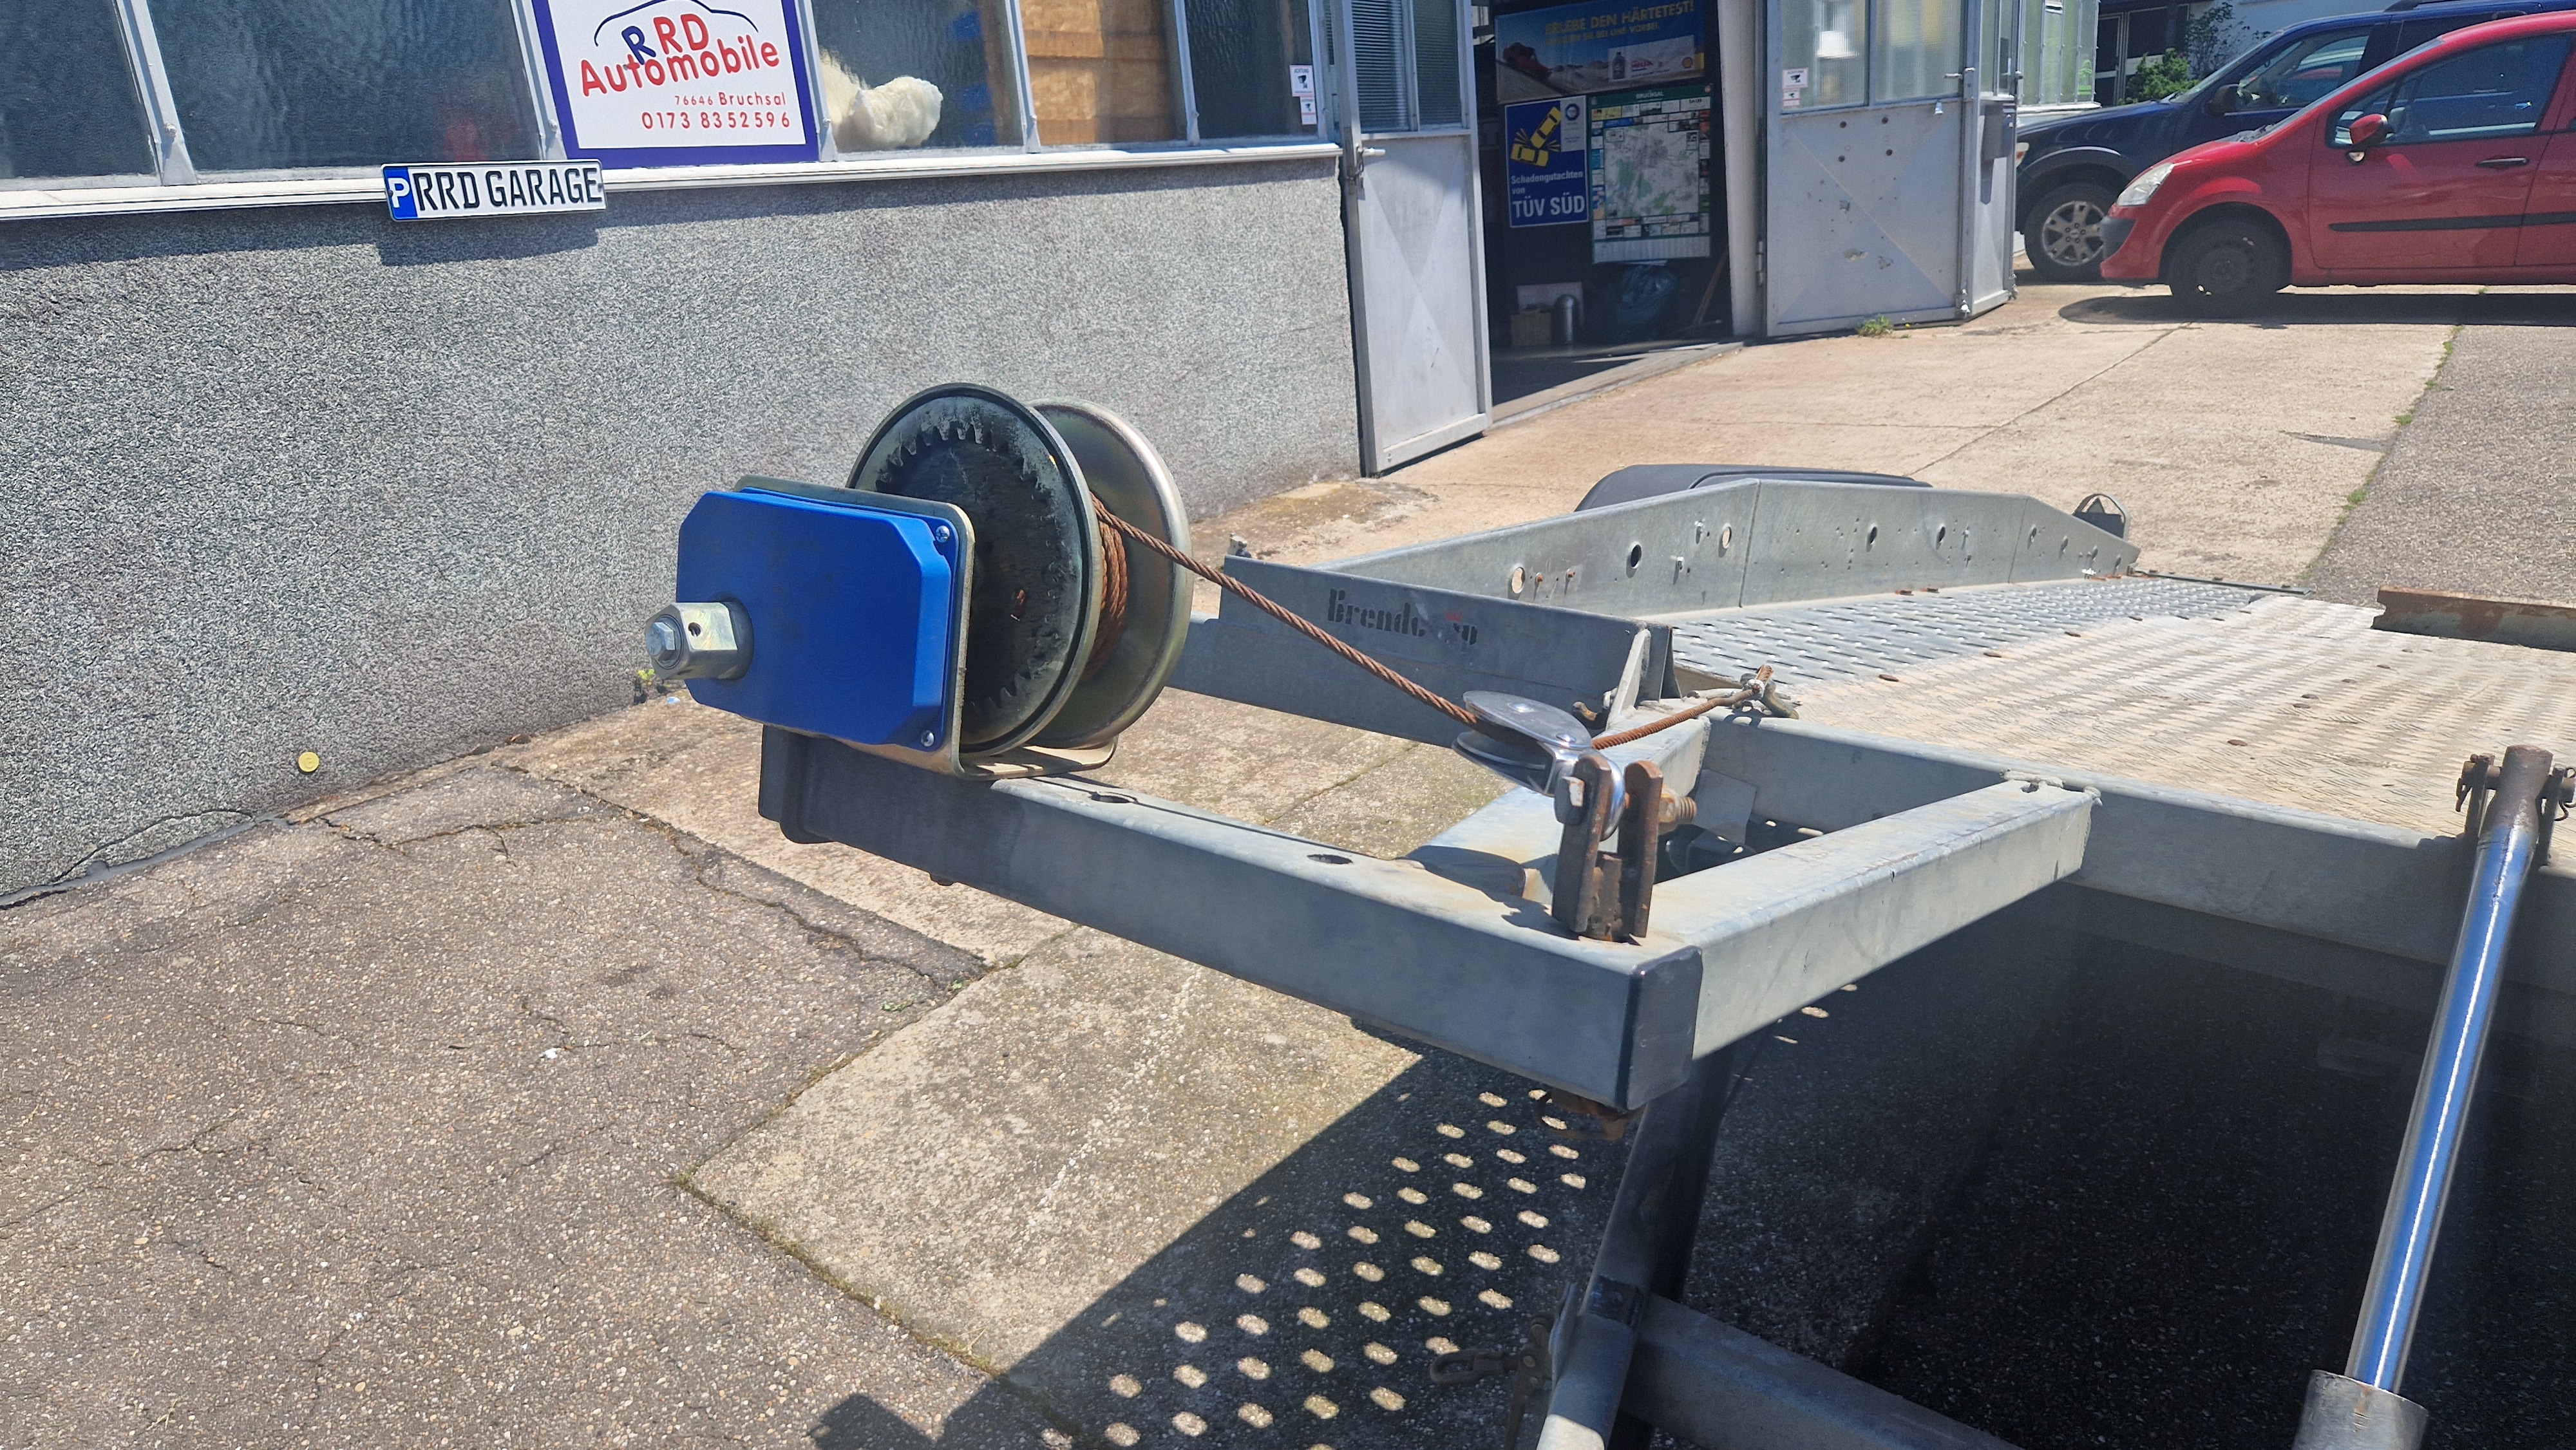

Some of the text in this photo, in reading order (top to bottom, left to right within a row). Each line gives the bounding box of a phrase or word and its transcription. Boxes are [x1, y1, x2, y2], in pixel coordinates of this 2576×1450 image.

[1545, 1, 1695, 35] ERLEBE DEN HÄRTETEST!
[580, 35, 780, 97] Automobile
[674, 91, 786, 106] 76646 Bruchsal
[641, 111, 790, 129] 0173 8352596
[413, 171, 480, 211] RRD
[485, 167, 603, 207] GARAGE
[1511, 170, 1584, 184] Schadengutachten
[1511, 186, 1526, 194] von
[1513, 192, 1586, 218] TÜV SÜD
[1327, 588, 1479, 645] Brendep
